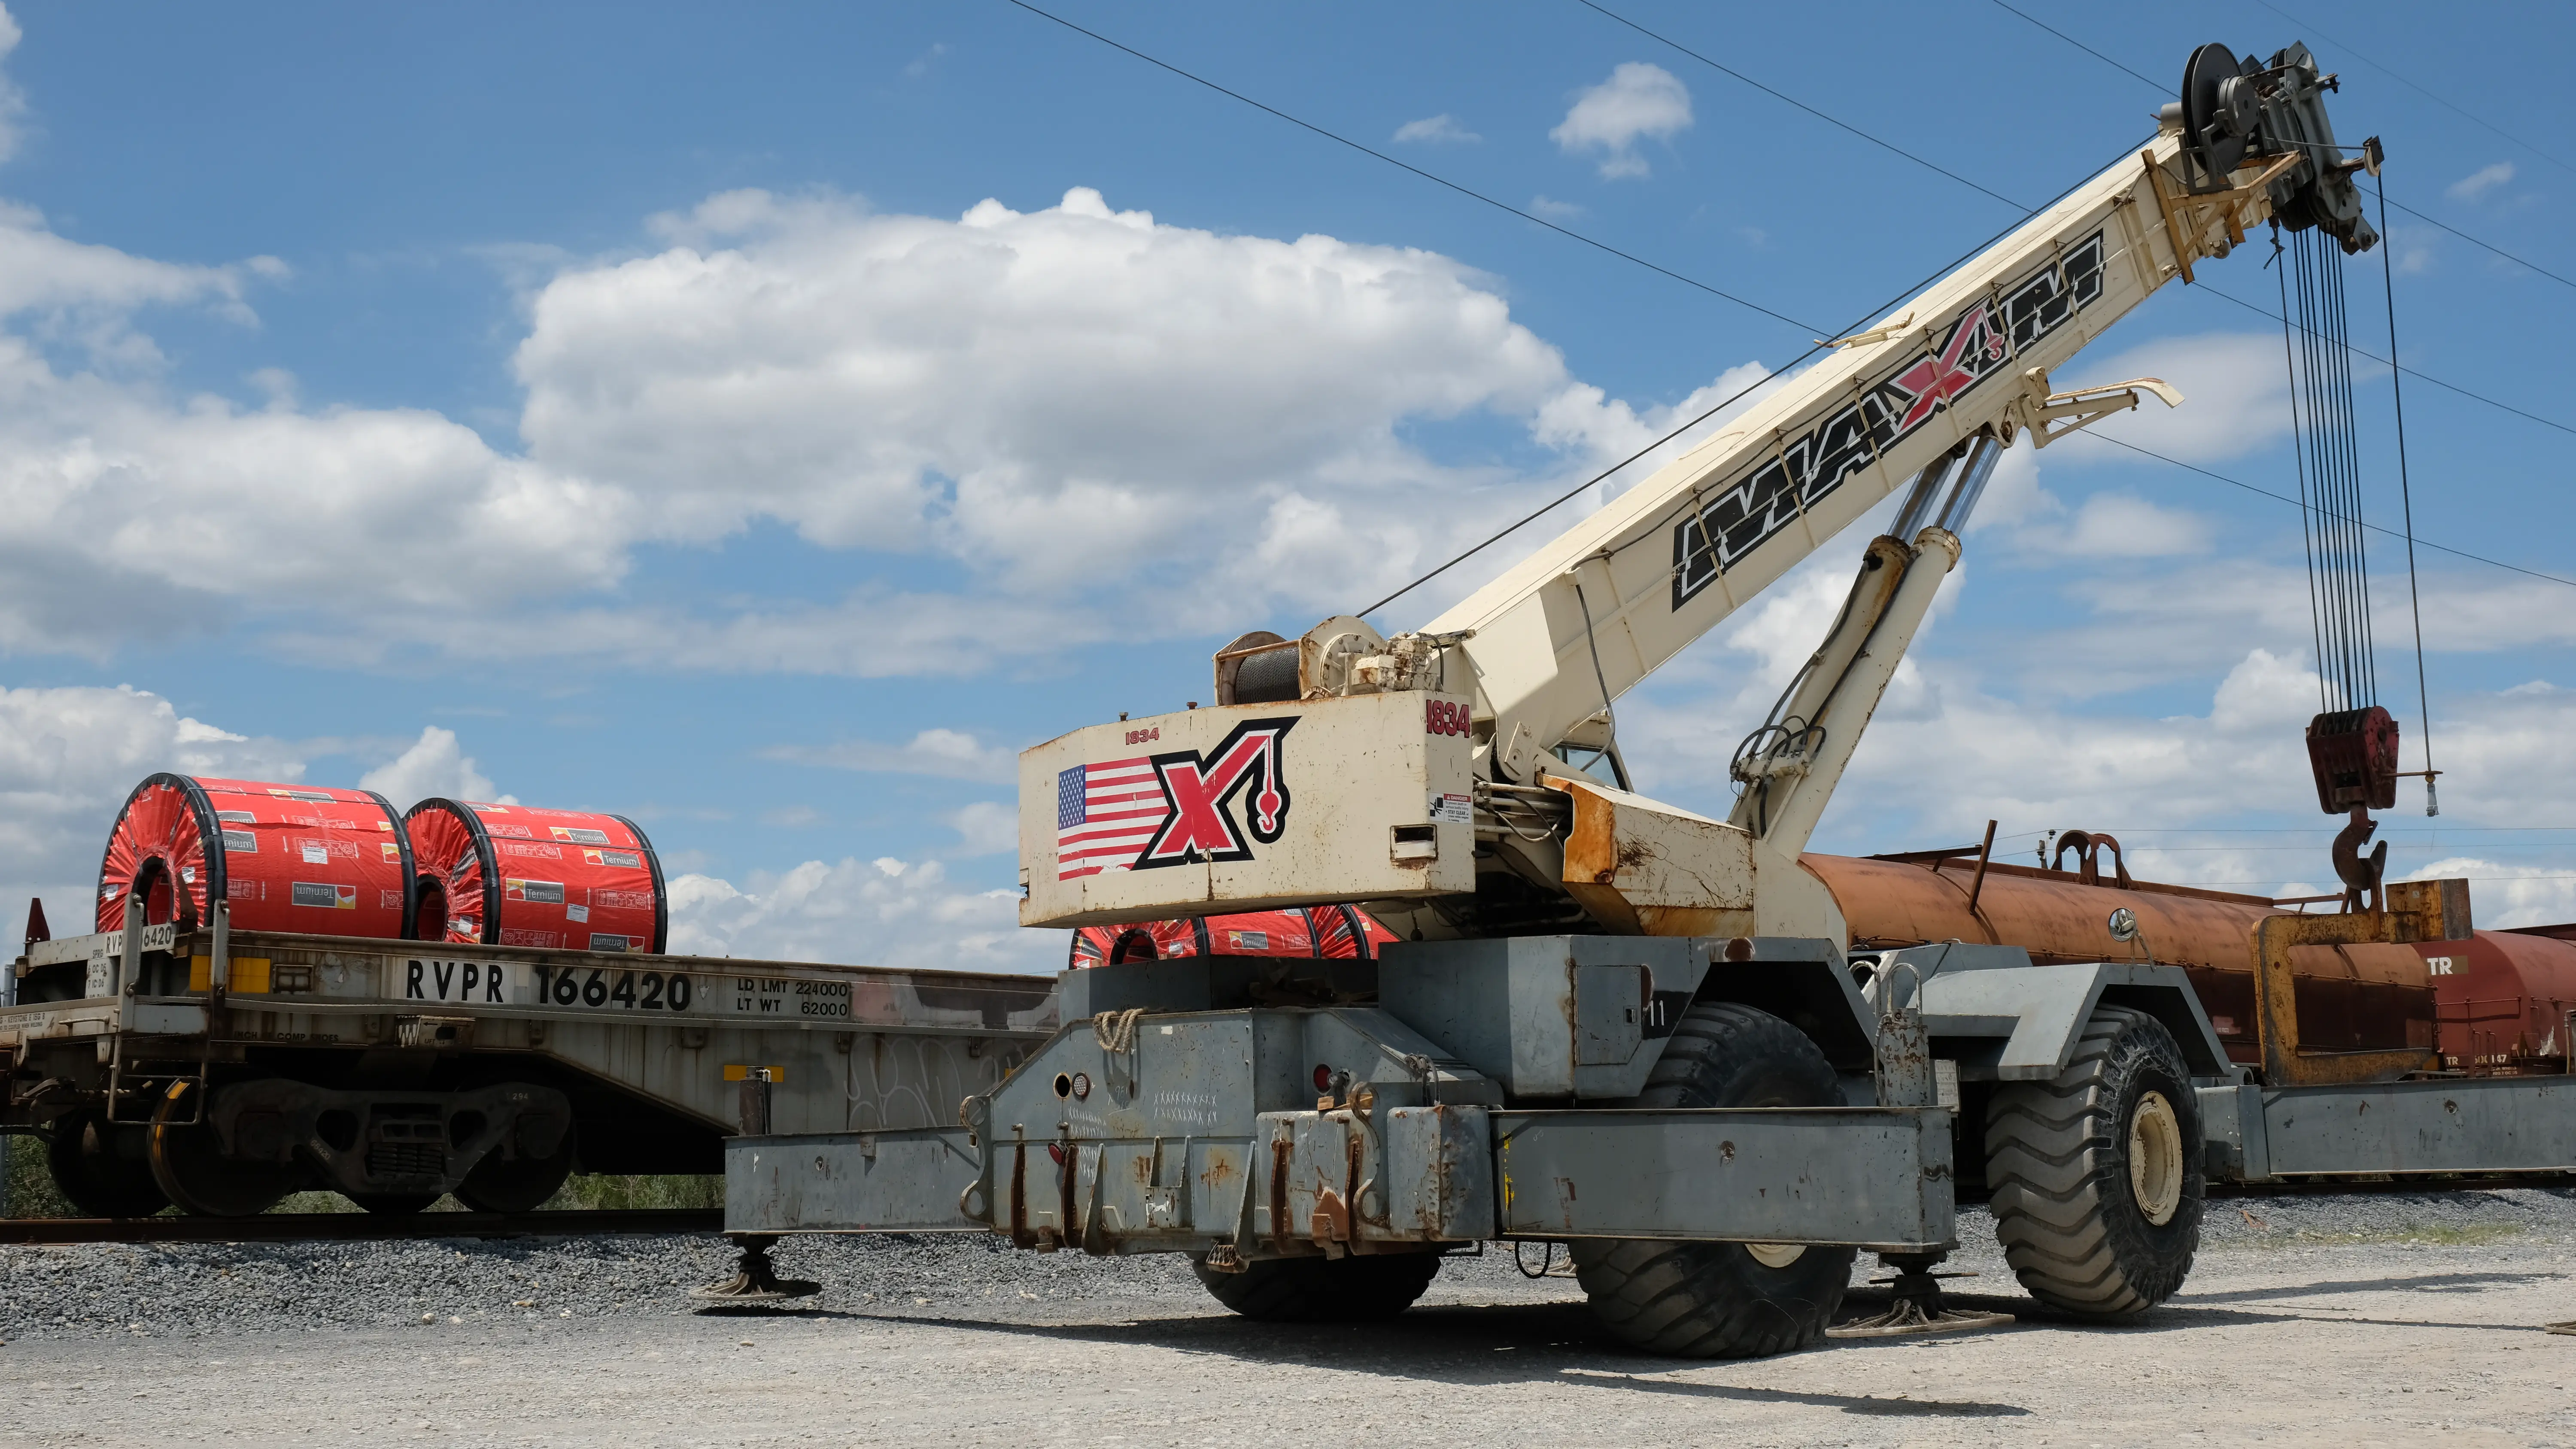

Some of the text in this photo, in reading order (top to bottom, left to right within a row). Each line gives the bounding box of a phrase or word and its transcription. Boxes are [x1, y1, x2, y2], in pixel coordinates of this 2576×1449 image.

[1426, 700, 1470, 738] 1834
[1126, 728, 1159, 745] 1834
[224, 839, 252, 849] rnium
[604, 855, 637, 866] Ternium
[296, 885, 334, 898] Ternium
[527, 888, 561, 900] Ternium
[106, 934, 123, 954] RVP
[142, 925, 172, 948] 6420
[593, 937, 625, 949] Ternium
[1243, 938, 1266, 946] Ternium
[2427, 957, 2453, 975] TR
[407, 960, 691, 1012] RVPR 166420
[738, 978, 848, 997] LD LMT 224000
[738, 998, 848, 1016] LT WT 62000
[2446, 1056, 2459, 1065] TR
